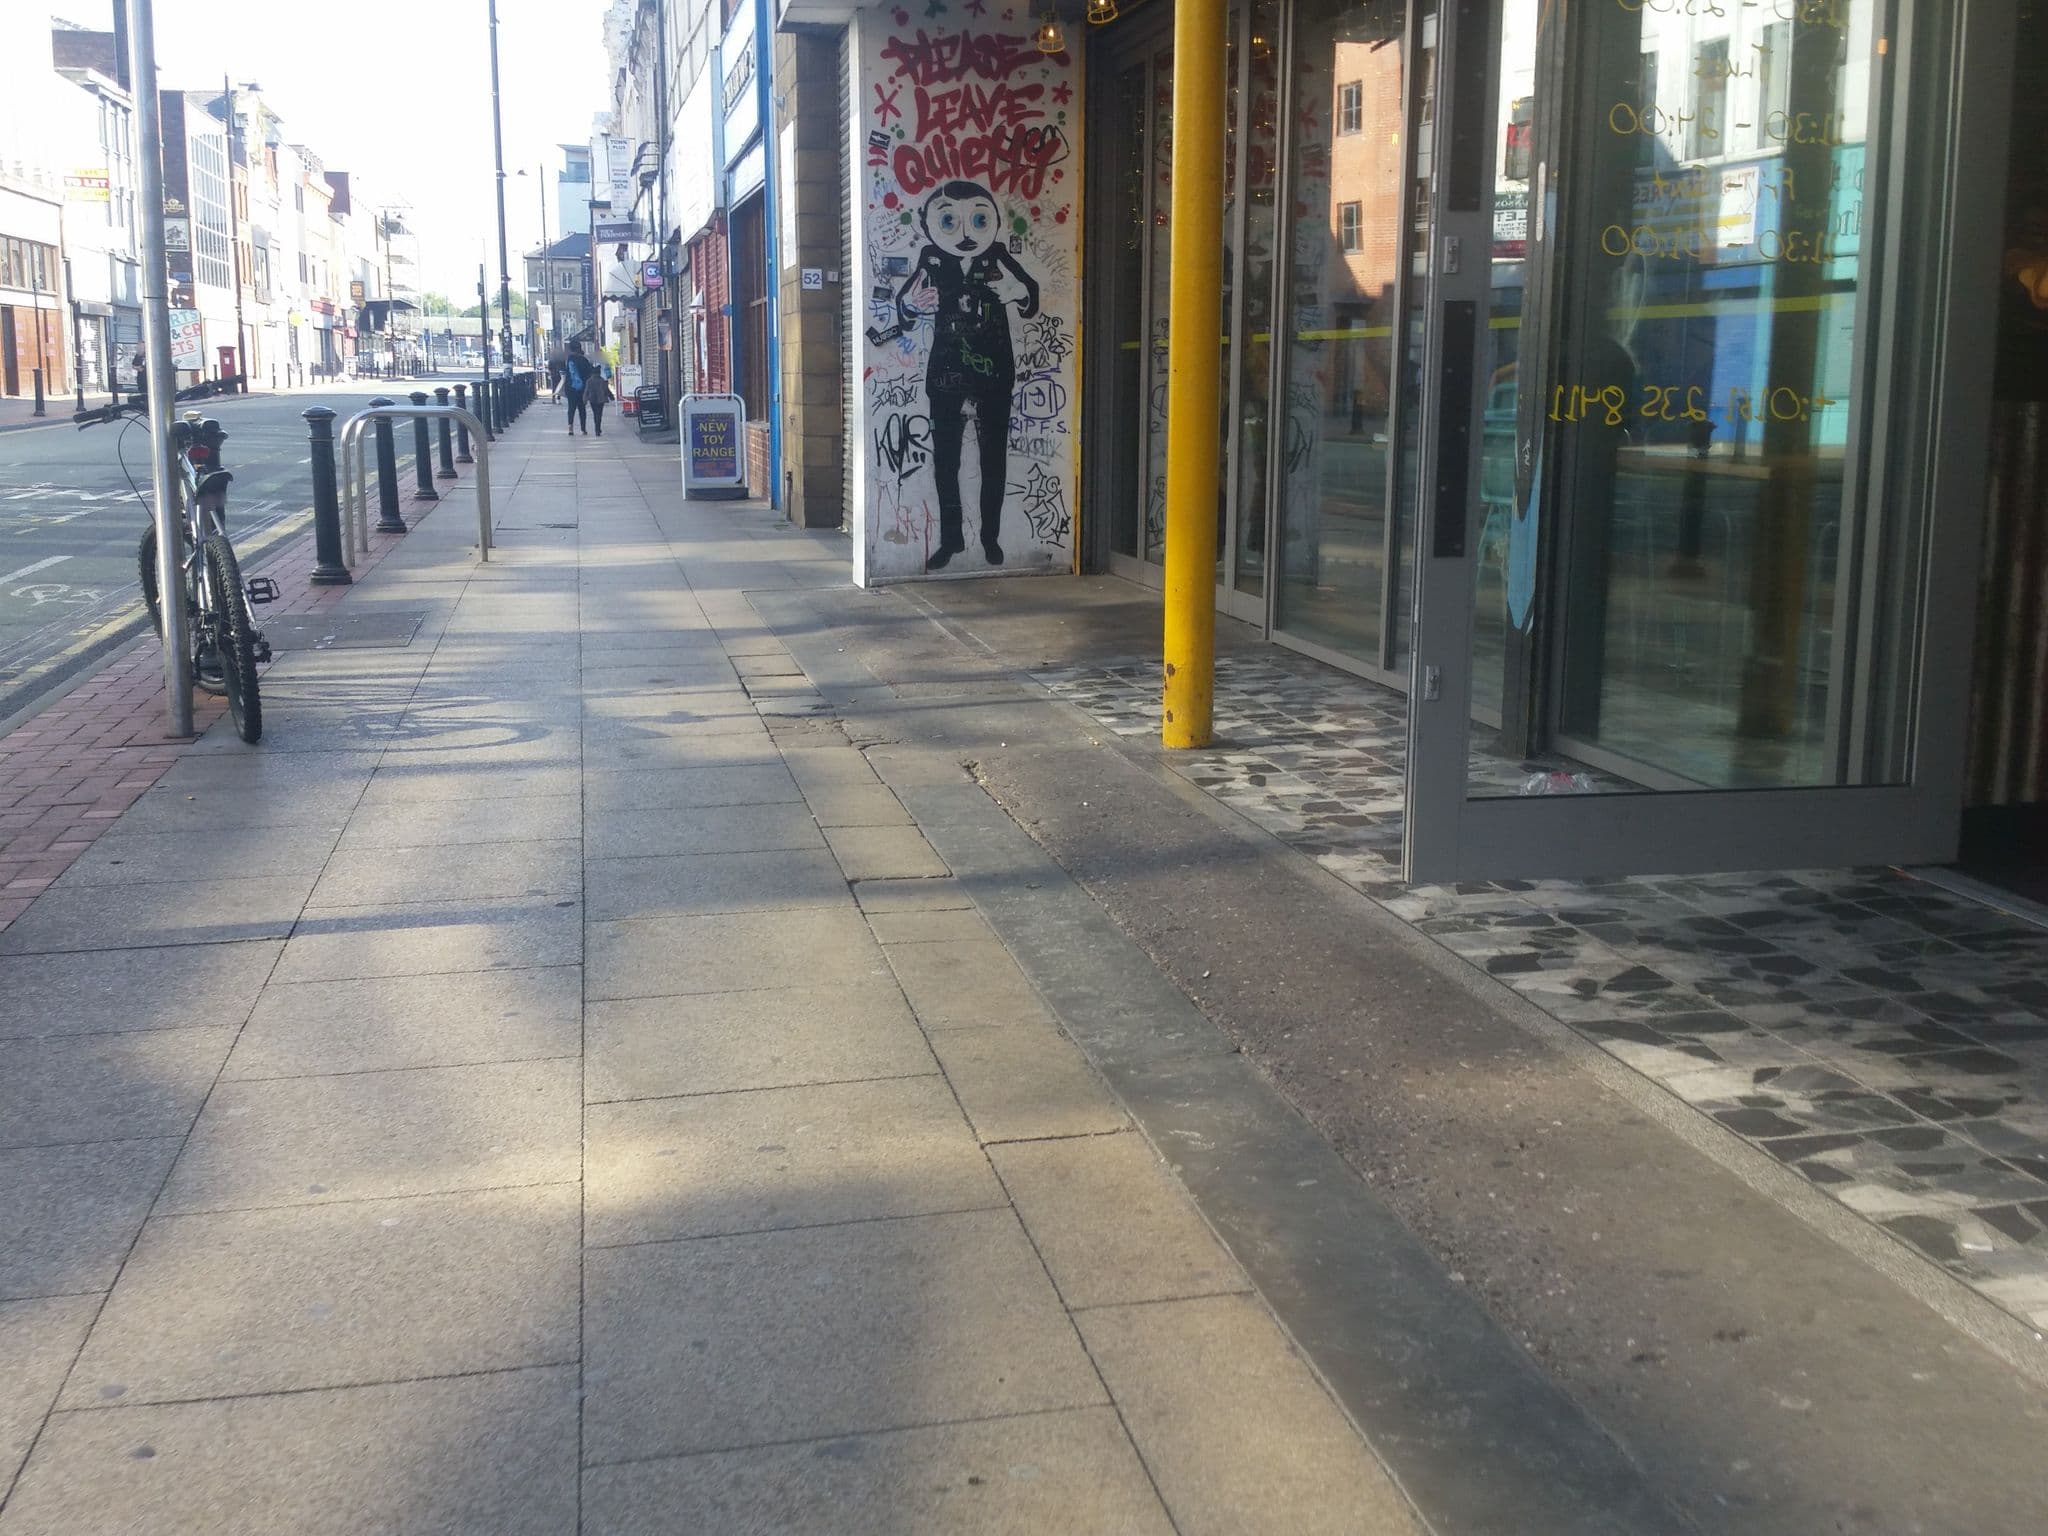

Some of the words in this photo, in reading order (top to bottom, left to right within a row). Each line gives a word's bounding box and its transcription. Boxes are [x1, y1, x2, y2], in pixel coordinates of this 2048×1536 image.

[881, 28, 1045, 86] PLEASE
[914, 82, 1045, 142] LEAVE
[804, 273, 820, 285] 52
[699, 422, 728, 432] NEW
[1009, 416, 1036, 436] RIP
[703, 434, 725, 445] TOY
[692, 447, 736, 457] RANGE
